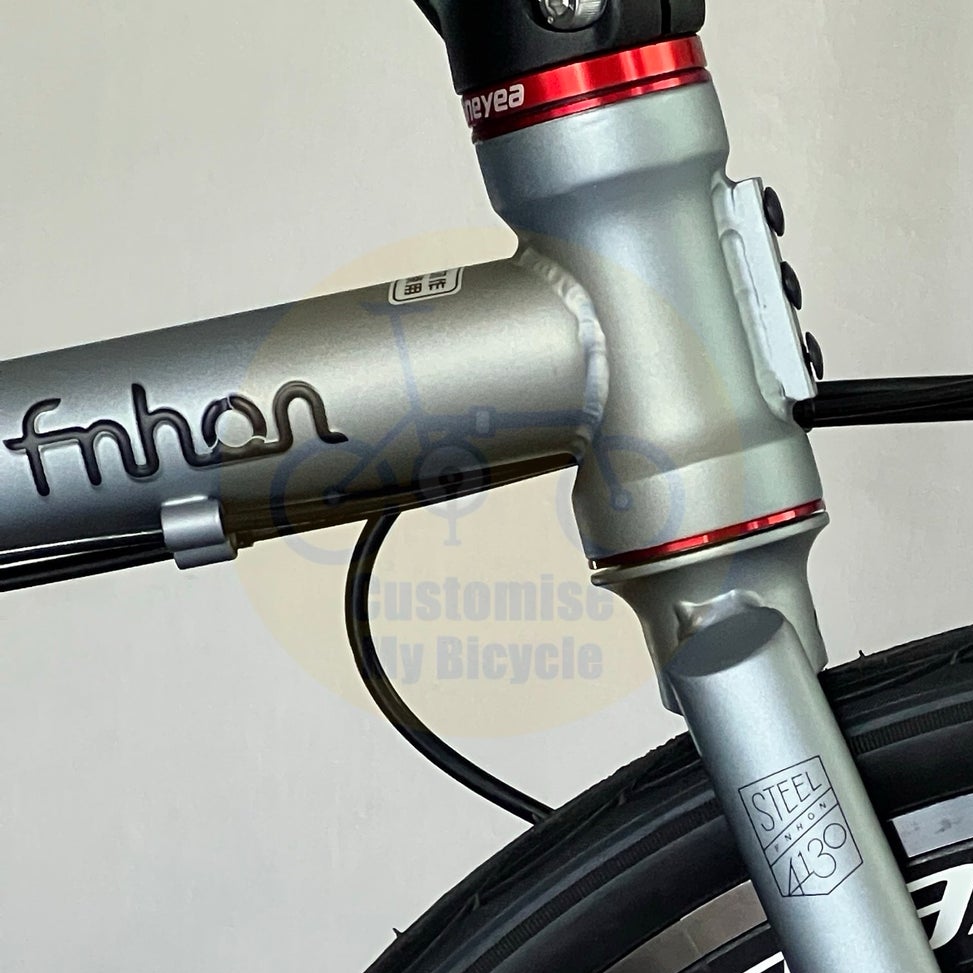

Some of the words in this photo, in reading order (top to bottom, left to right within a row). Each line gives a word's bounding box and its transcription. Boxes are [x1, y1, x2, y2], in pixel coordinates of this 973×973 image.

[2, 381, 348, 497] fnhon
[751, 771, 822, 832] STEEL
[787, 822, 847, 896] 4130
